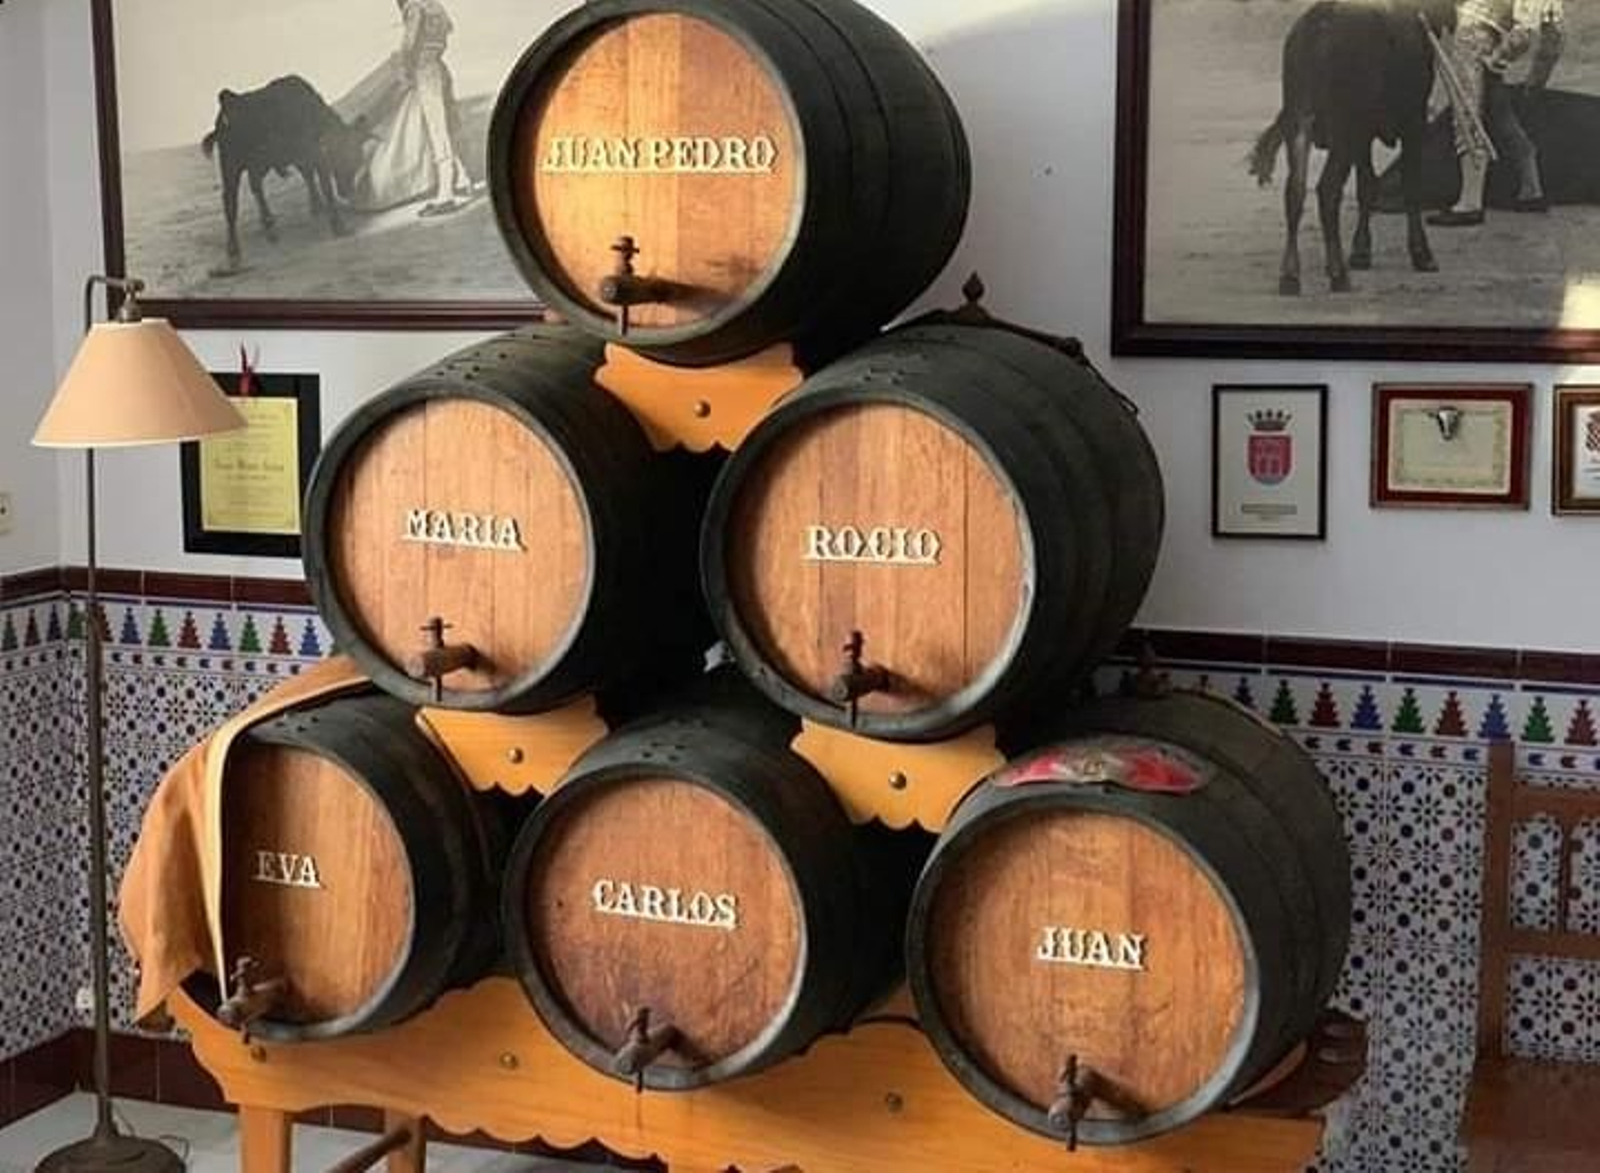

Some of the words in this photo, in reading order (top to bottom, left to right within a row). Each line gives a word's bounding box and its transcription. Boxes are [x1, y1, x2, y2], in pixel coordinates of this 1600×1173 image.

[543, 136, 641, 173] JUAN
[648, 136, 777, 173] PEDRO
[403, 509, 521, 551] MARIA
[804, 524, 940, 563] ROCIO
[252, 850, 320, 888] EVA
[592, 879, 737, 931] CARLOS
[1036, 926, 1144, 970] JUAN
